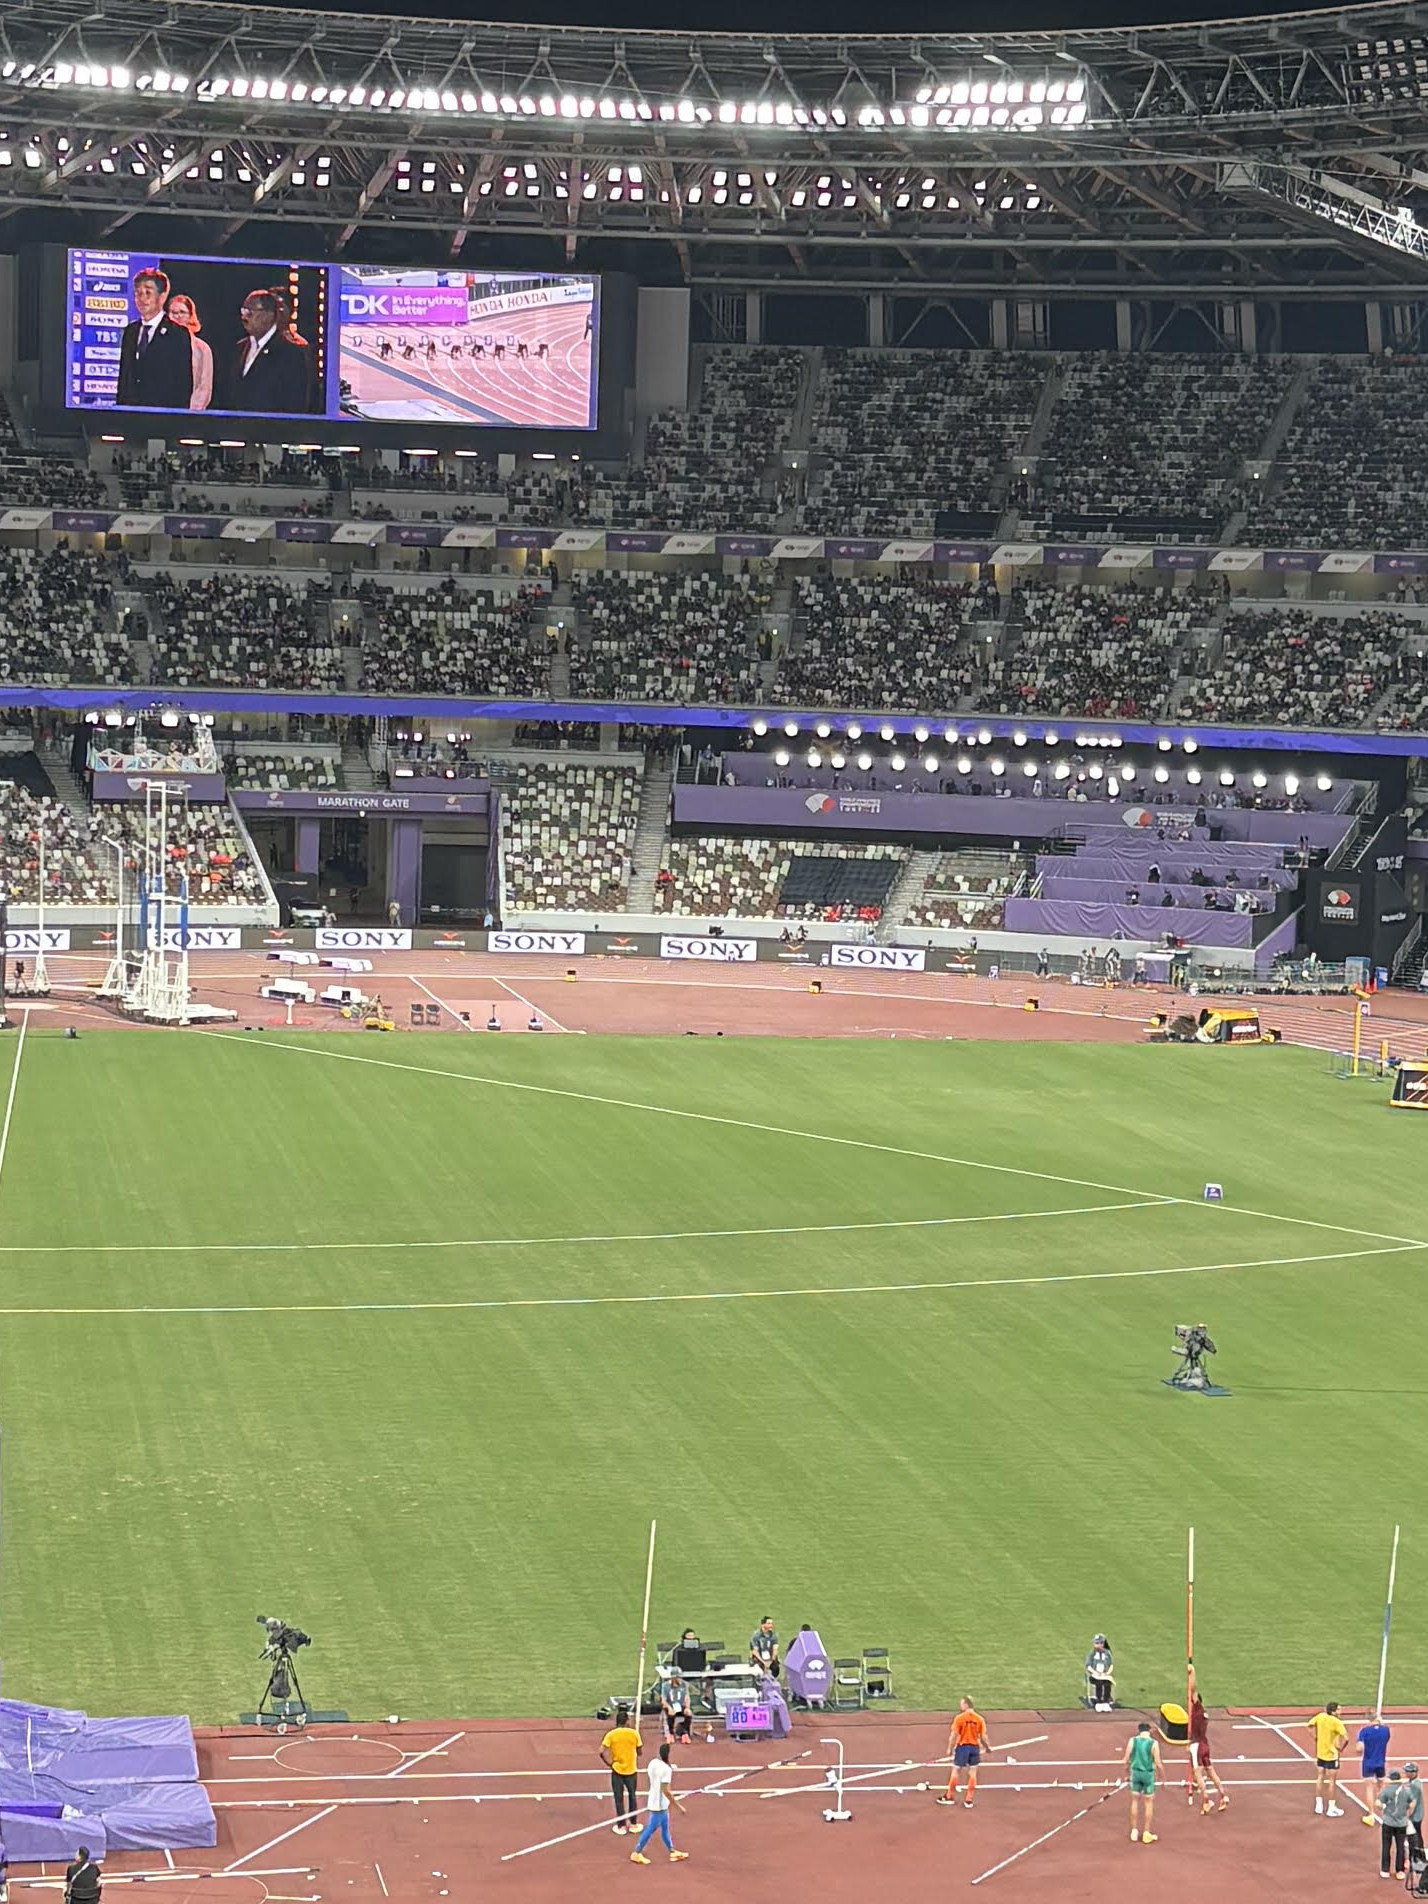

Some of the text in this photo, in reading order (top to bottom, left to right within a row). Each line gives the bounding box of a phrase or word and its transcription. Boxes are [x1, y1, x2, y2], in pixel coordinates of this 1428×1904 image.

[96, 331, 118, 343] TBS
[317, 796, 410, 809] MARATHON GATE
[322, 931, 405, 947] SONY
[494, 934, 579, 951] SONY
[667, 940, 749, 959] SONY
[837, 948, 920, 968] SONY
